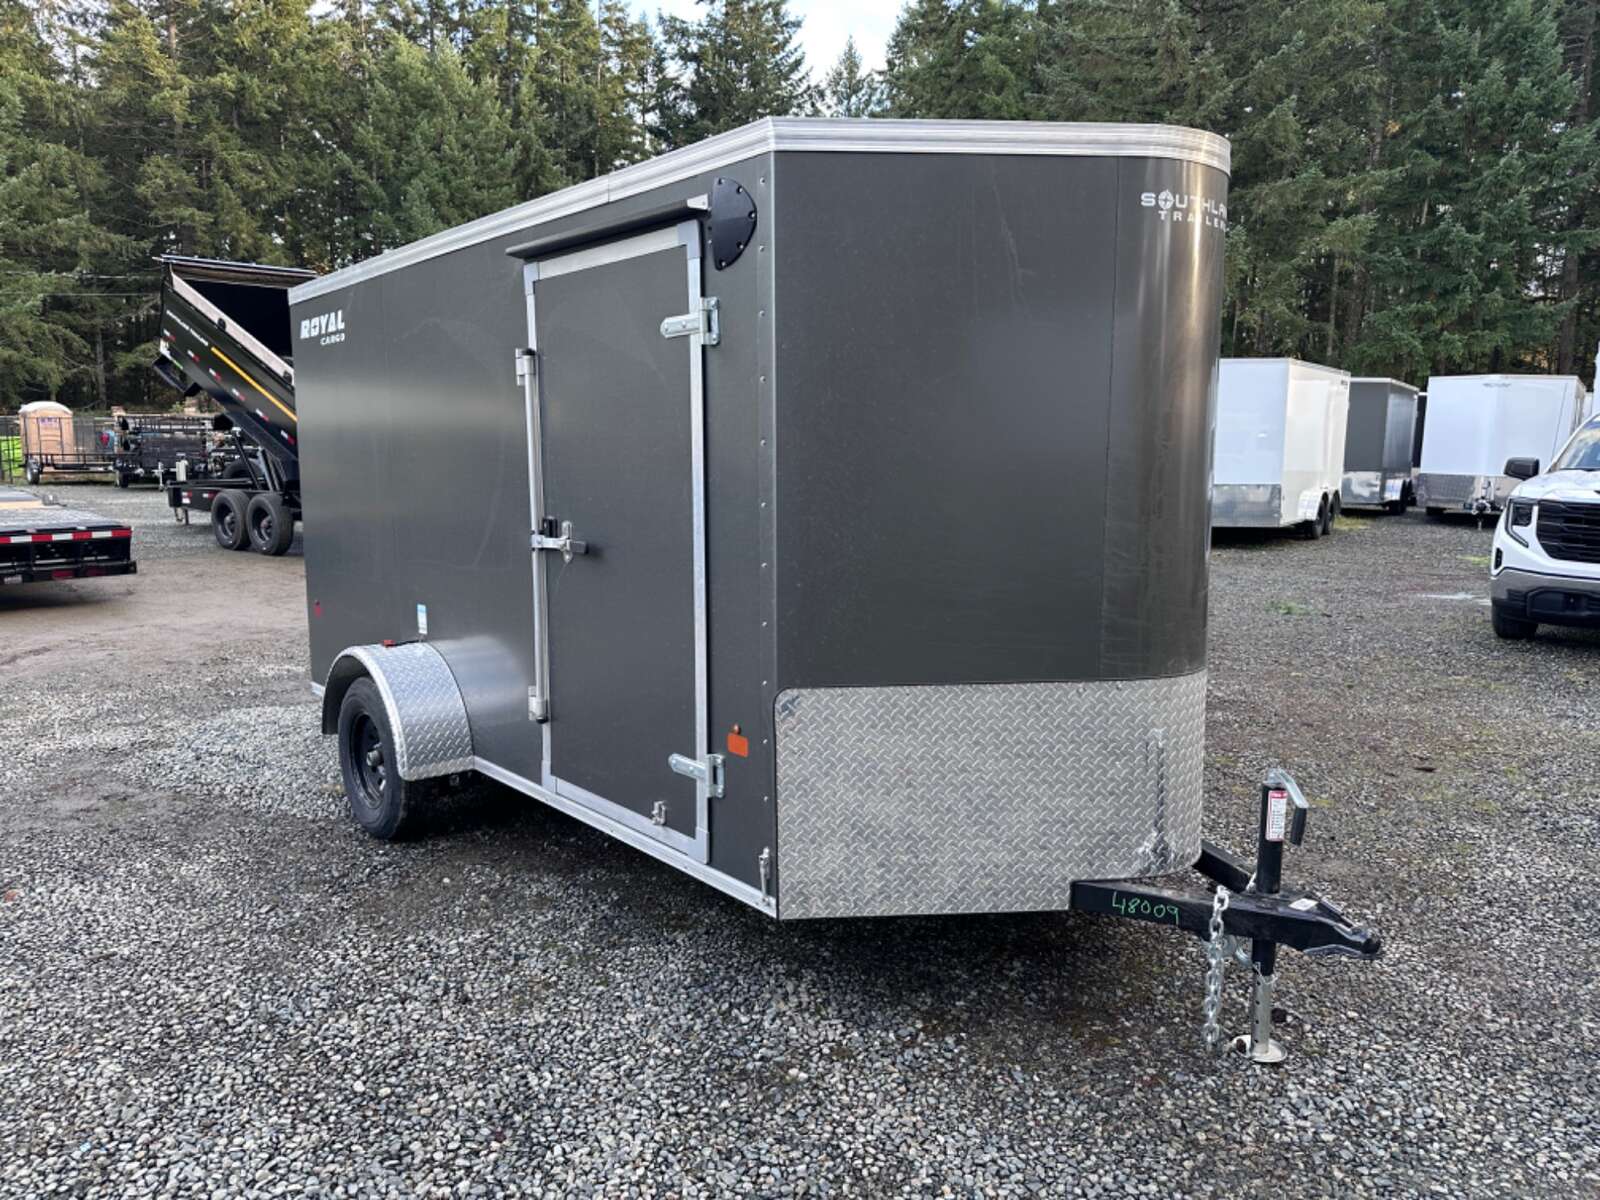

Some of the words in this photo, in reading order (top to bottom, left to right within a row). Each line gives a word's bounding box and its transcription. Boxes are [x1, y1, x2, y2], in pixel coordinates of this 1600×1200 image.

[300, 309, 345, 340] ROYAL
[320, 333, 345, 346] CARGO
[1112, 891, 1179, 926] 48009
